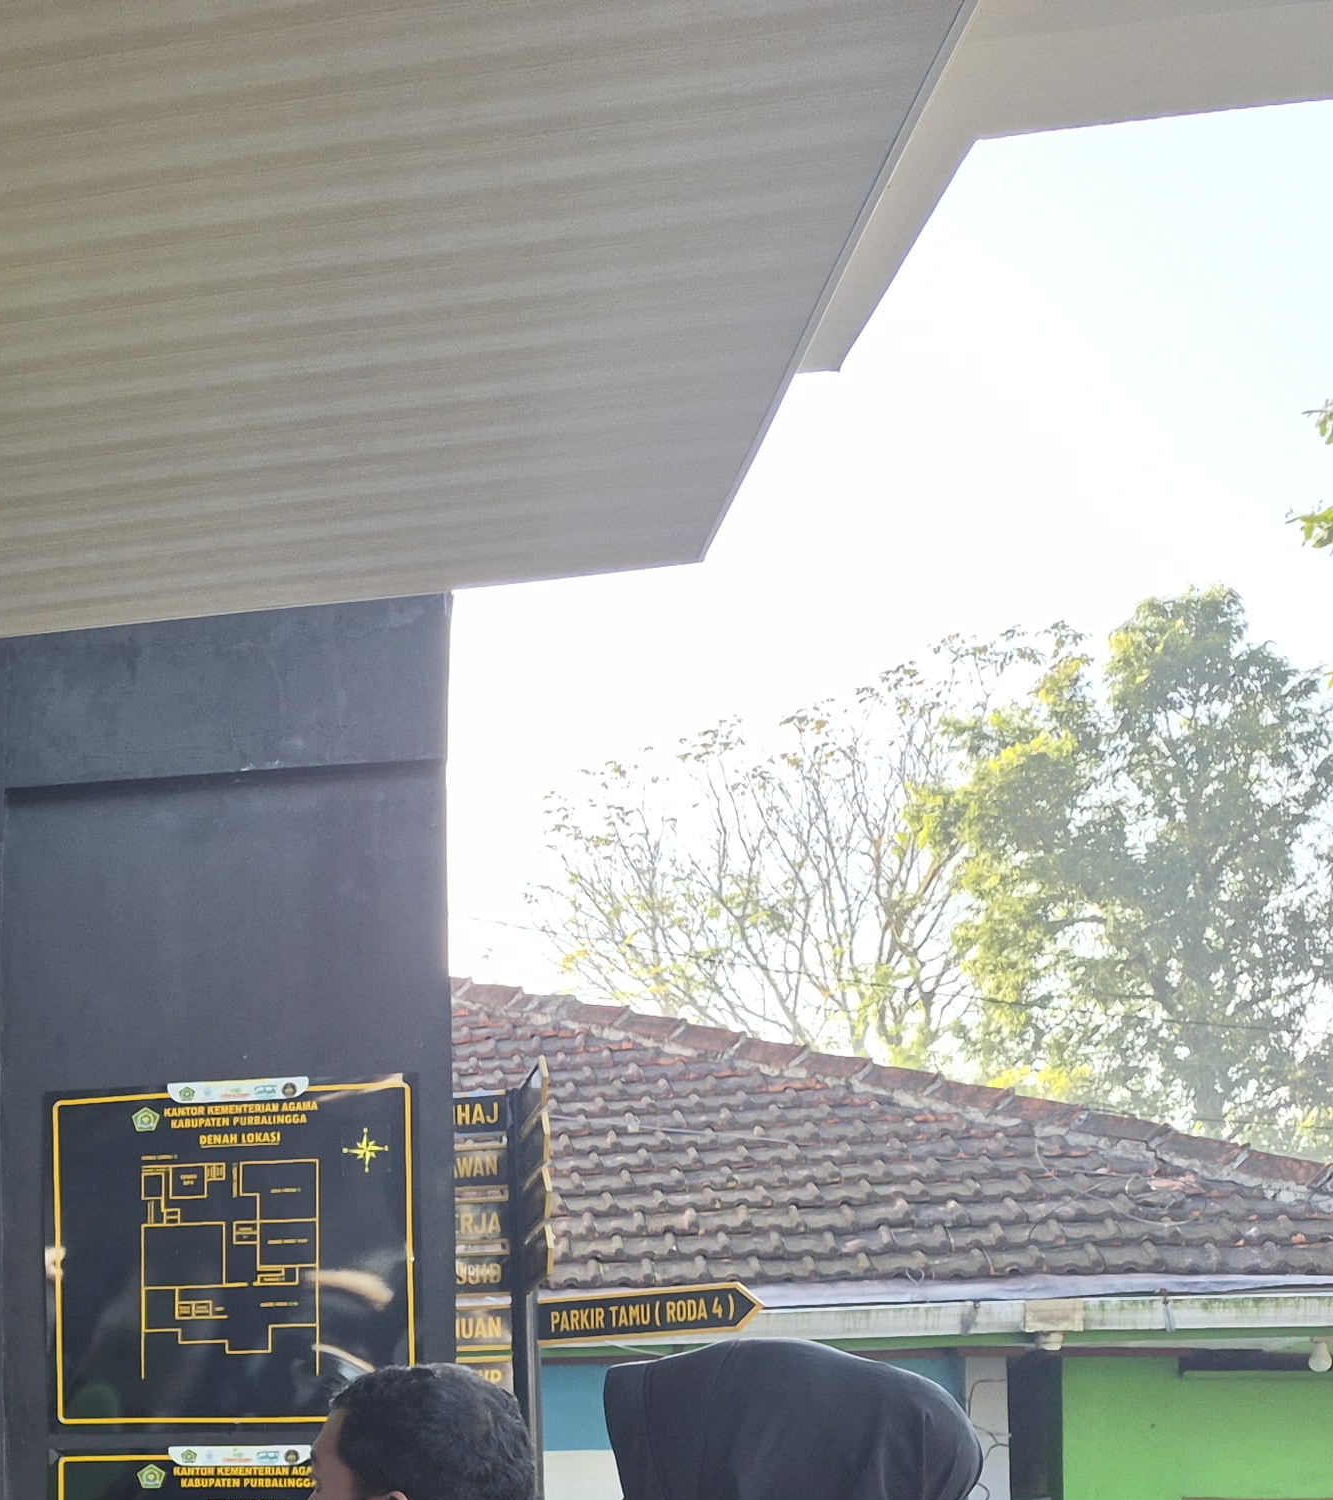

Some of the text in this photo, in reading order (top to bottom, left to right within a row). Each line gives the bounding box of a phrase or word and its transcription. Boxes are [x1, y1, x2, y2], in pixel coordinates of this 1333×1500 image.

[164, 1101, 319, 1118] KANTOR KEMENTERIAN AGAMA
[453, 1102, 500, 1126] HAJ
[170, 1114, 307, 1129] KABUPATEN PURBALINGGA
[199, 1131, 281, 1145] DENAH LOKASI
[456, 1212, 502, 1235] RJA
[550, 1296, 723, 1333] PARKIR TAMU RODA 4
[173, 1466, 290, 1476] KANTOR KEMENTERIAN
[180, 1478, 241, 1488] KABUPATEN
